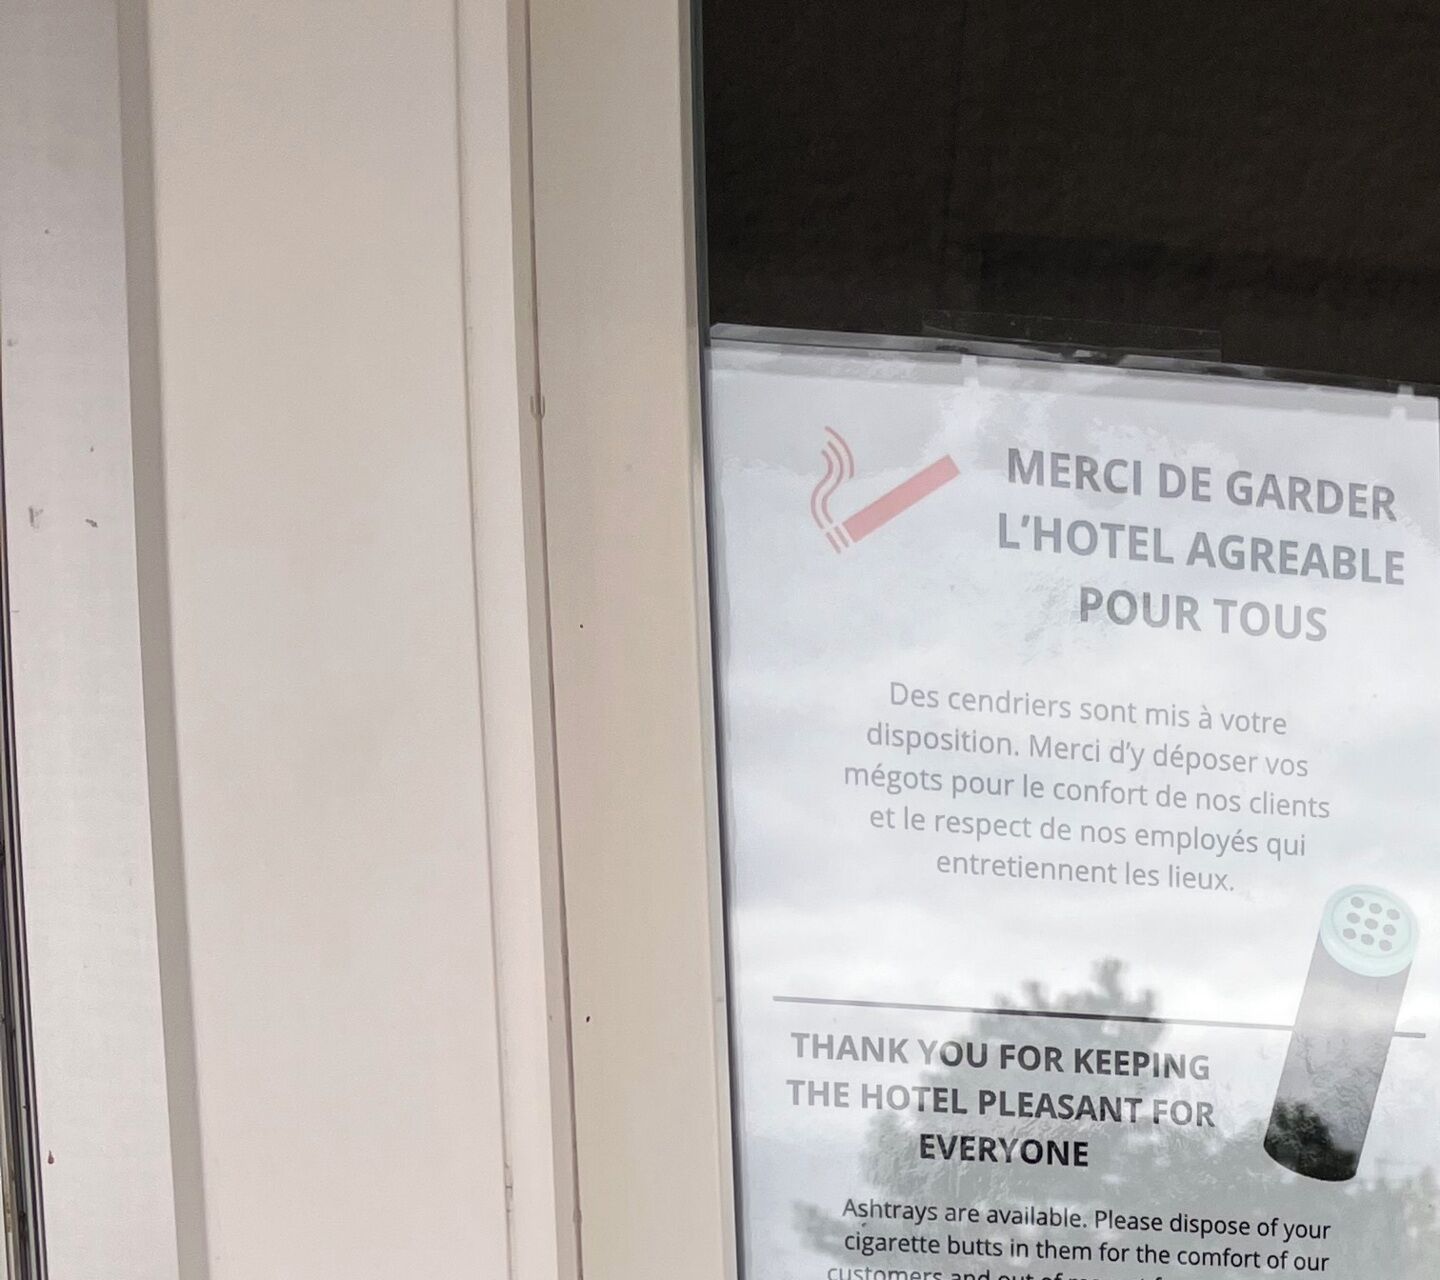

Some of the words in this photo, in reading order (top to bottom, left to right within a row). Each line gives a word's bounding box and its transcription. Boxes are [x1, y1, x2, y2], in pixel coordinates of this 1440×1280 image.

[1008, 448, 1141, 495] MERCI
[1159, 463, 1211, 502] DE
[1227, 470, 1397, 521] GARDER
[999, 513, 1174, 564] L'HOTEL
[1186, 532, 1404, 585] AGREABLE
[1080, 587, 1201, 631] POUR
[1213, 598, 1327, 641] TOUS
[891, 682, 939, 708] Des
[948, 690, 1071, 718] cendriers
[1080, 703, 1136, 724] sont
[1146, 704, 1190, 727] mis
[1199, 705, 1212, 729] à
[1221, 712, 1286, 735] votre
[867, 722, 1018, 756] disposition.
[1030, 734, 1099, 762] Merci
[1110, 740, 1145, 771] d'y
[1153, 743, 1258, 775] déposer
[1265, 757, 1307, 776] vos
[845, 763, 942, 795] mégots
[952, 775, 1014, 799] pour
[1024, 774, 1044, 798] le
[1053, 780, 1148, 806] confort
[1156, 784, 1187, 808] de
[1197, 793, 1240, 812] nos
[1250, 791, 1329, 818] clients
[871, 808, 895, 829] et
[904, 806, 925, 831] le
[935, 815, 1031, 842] respect
[1040, 816, 1071, 840] de
[1081, 825, 1126, 844] nos
[1135, 826, 1258, 857] employés
[1267, 834, 1304, 861] qui
[937, 854, 1117, 884] entretiennent
[1126, 861, 1159, 886] les
[1169, 864, 1234, 891] lieux.
[791, 1032, 908, 1064] THANK
[918, 1040, 987, 1068] YOU
[1001, 1045, 1064, 1072] FOR
[1075, 1048, 1209, 1080] KEEPING
[786, 1080, 849, 1108] THE
[862, 1084, 967, 1117] HOTEL
[979, 1090, 1143, 1123] PLEASANT
[1153, 1100, 1216, 1128] FOR
[920, 1134, 1088, 1166] EVERYONE
[843, 1199, 937, 1227] Ashtrays
[945, 1207, 979, 1223] are
[987, 1206, 1087, 1228] available.
[1096, 1210, 1162, 1231] Please
[1170, 1213, 1250, 1239] dispose
[1257, 1218, 1279, 1236] of
[1283, 1223, 1331, 1243] your
[845, 1232, 940, 1256] cigarette
[948, 1235, 1002, 1256] butts
[1011, 1239, 1028, 1257] in
[1036, 1239, 1091, 1260] them
[1099, 1242, 1130, 1262] for
[1136, 1244, 1170, 1264] the
[1178, 1248, 1260, 1268] comfort
[1267, 1250, 1288, 1269] of
[1294, 1256, 1329, 1271] our
